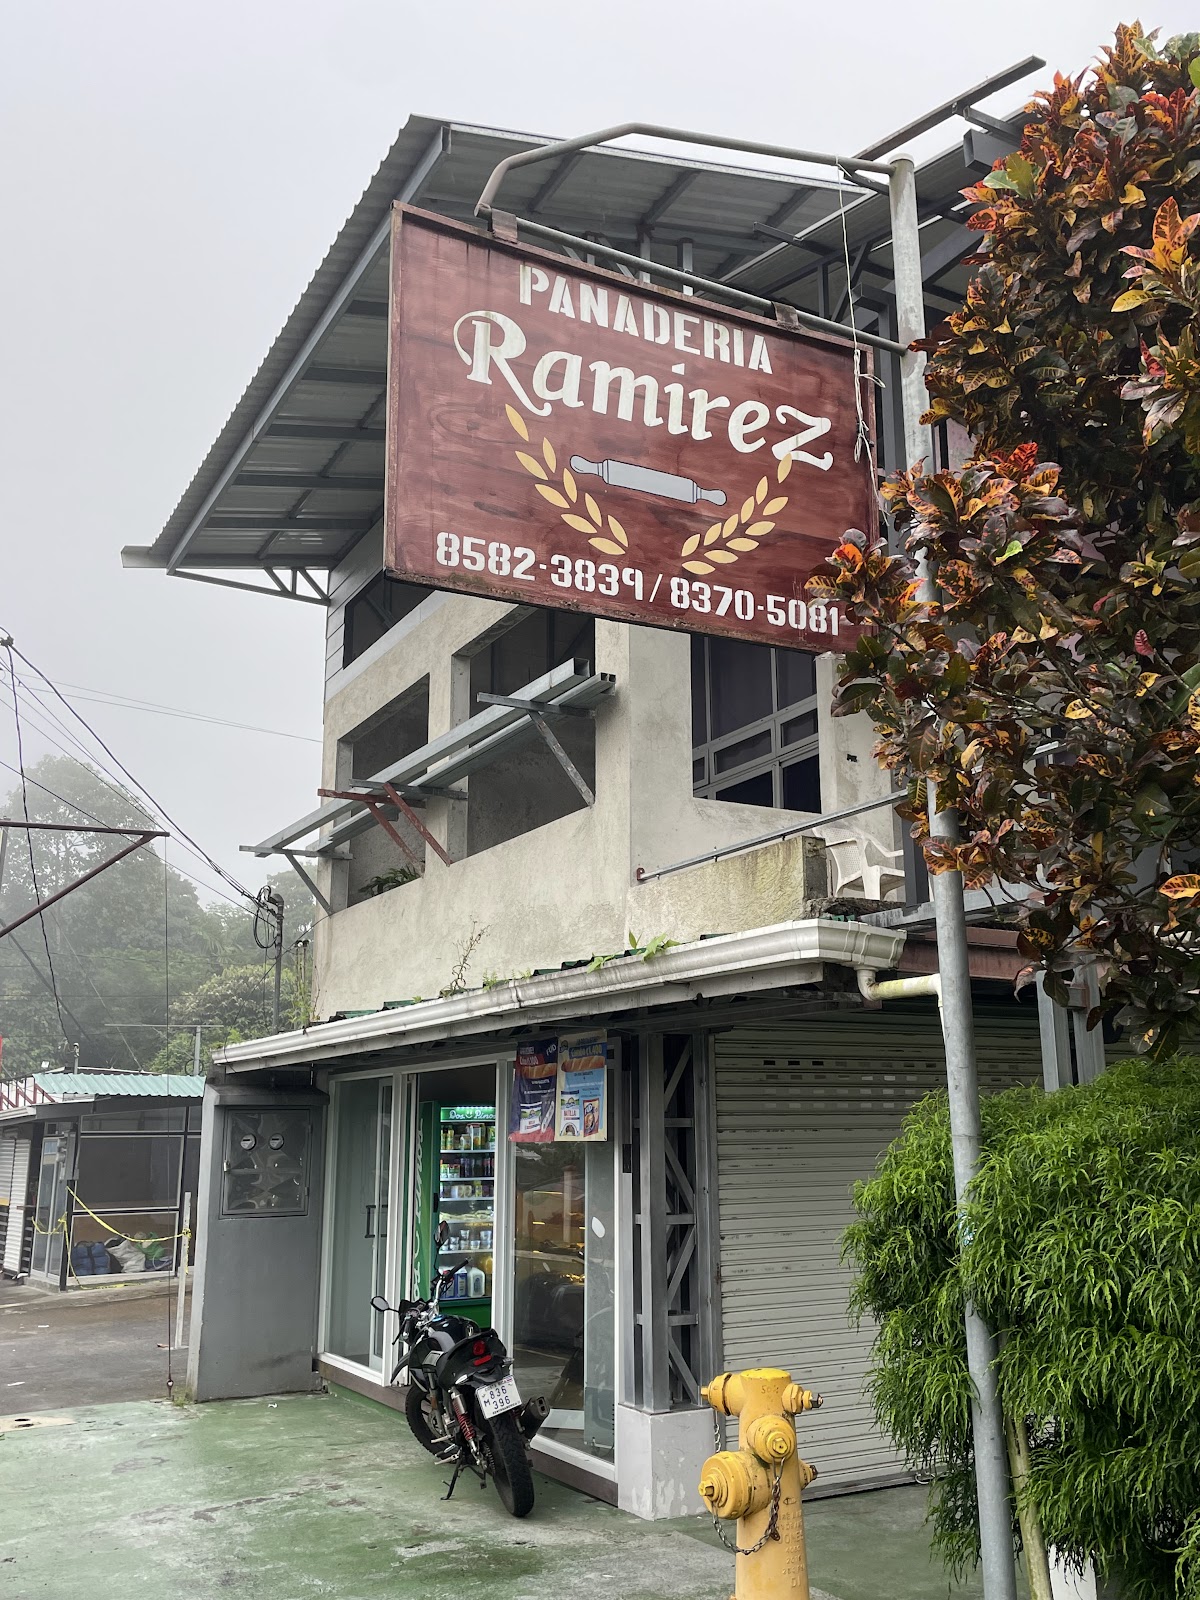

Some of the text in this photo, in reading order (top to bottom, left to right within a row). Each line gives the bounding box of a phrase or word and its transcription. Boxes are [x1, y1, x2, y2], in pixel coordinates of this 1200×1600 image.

[519, 264, 774, 375] PANADERIA
[436, 532, 644, 601] 8582-3839
[670, 576, 840, 636] 8370-5081
[449, 1110, 465, 1119] Dos
[489, 1386, 507, 1399] 836
[484, 1396, 510, 1409] M 396
